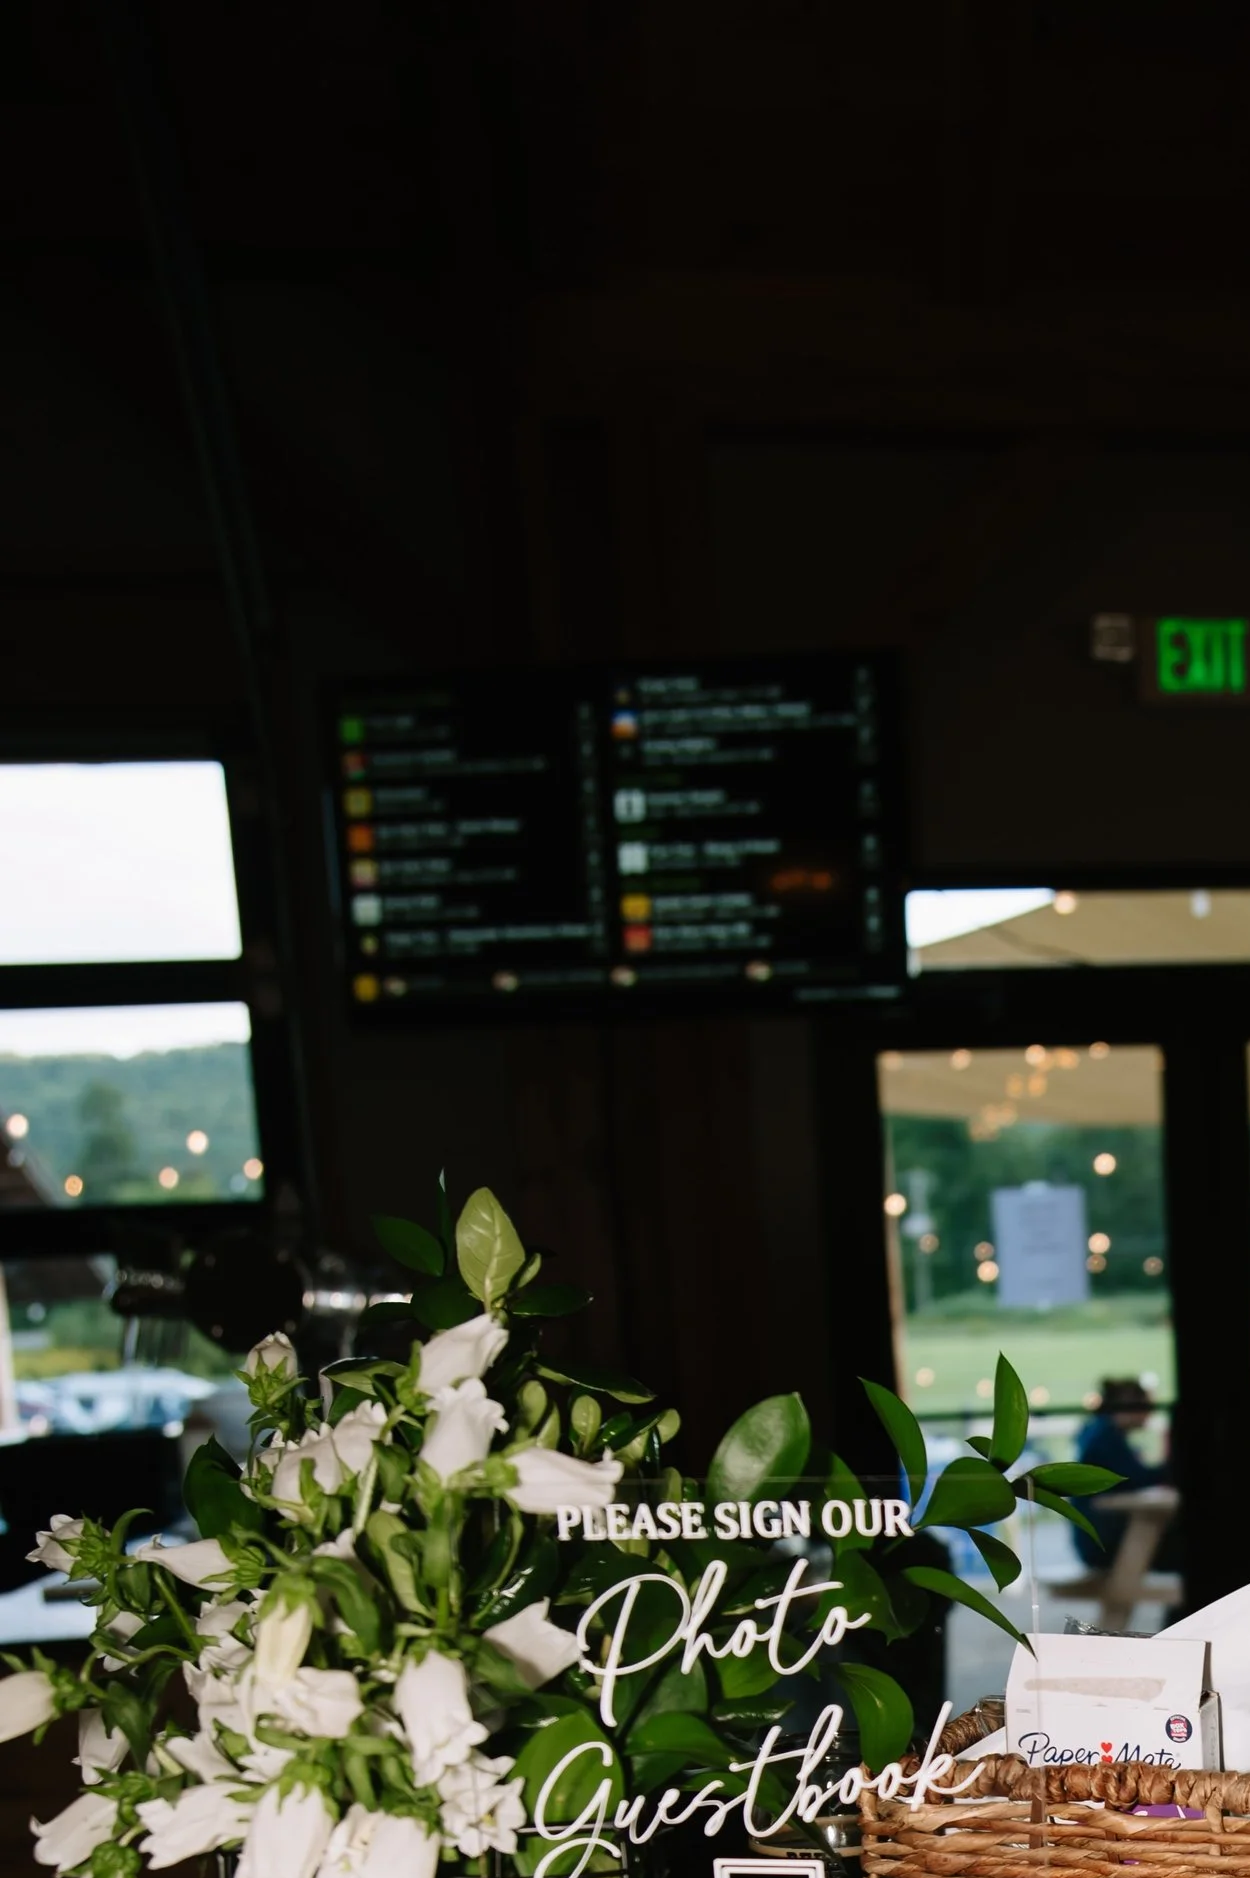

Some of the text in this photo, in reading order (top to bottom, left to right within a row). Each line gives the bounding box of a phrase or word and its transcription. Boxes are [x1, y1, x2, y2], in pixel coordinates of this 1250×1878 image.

[1156, 616, 1247, 693] EXIT
[557, 1498, 915, 1541] PLEASE SIGN OUR
[577, 1558, 871, 1727] Photo
[1018, 1732, 1100, 1765] Paper
